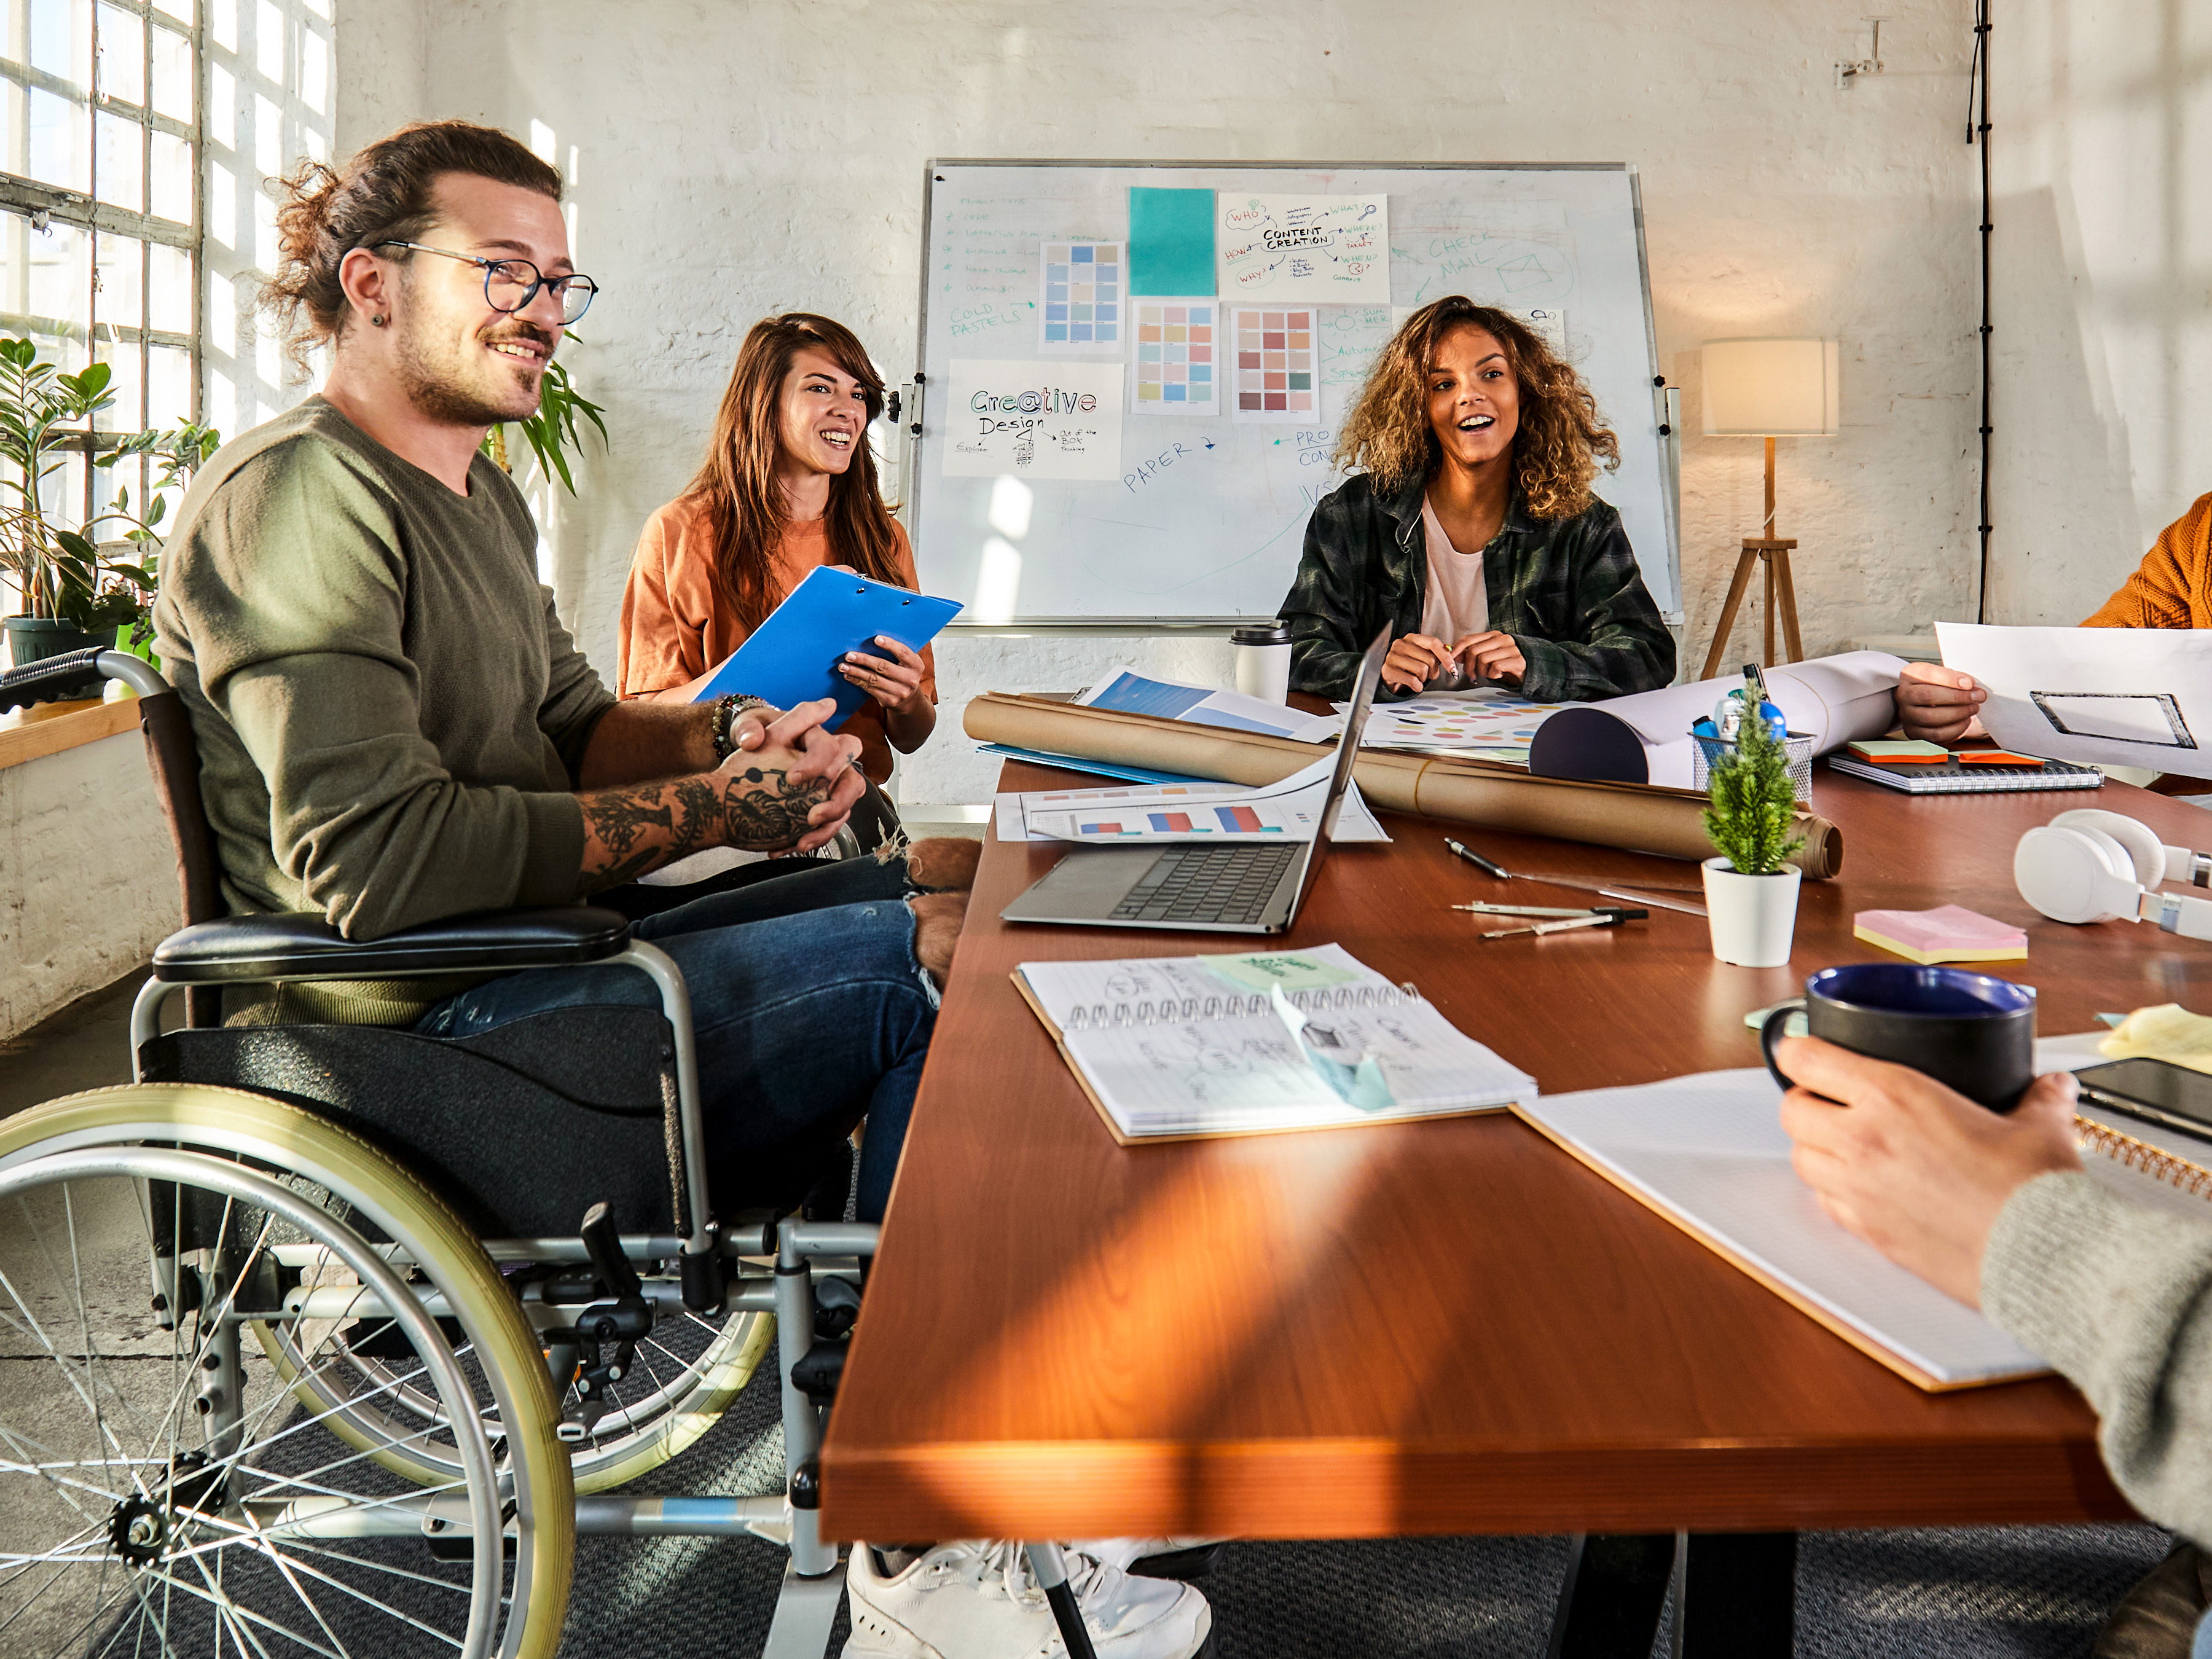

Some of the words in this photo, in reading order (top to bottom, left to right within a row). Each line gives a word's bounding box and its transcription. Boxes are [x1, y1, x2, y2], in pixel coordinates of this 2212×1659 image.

[1231, 211, 1259, 221] WHO
[1330, 203, 1366, 214] WHAT?
[1263, 227, 1322, 240] CONTENT
[1267, 236, 1328, 249] CREATION
[1346, 241, 1373, 249] TARGET
[1429, 232, 1495, 258] CHECK
[1225, 246, 1246, 261] HOW
[1340, 254, 1378, 264] WHEN?
[1440, 253, 1496, 278] MAIL
[1239, 267, 1266, 283] WHY?
[950, 304, 993, 323] COLD
[951, 310, 1021, 337] PASTELS
[979, 417, 1044, 441] Design
[1296, 430, 1330, 446] PRO
[1124, 442, 1193, 493] PAPER
